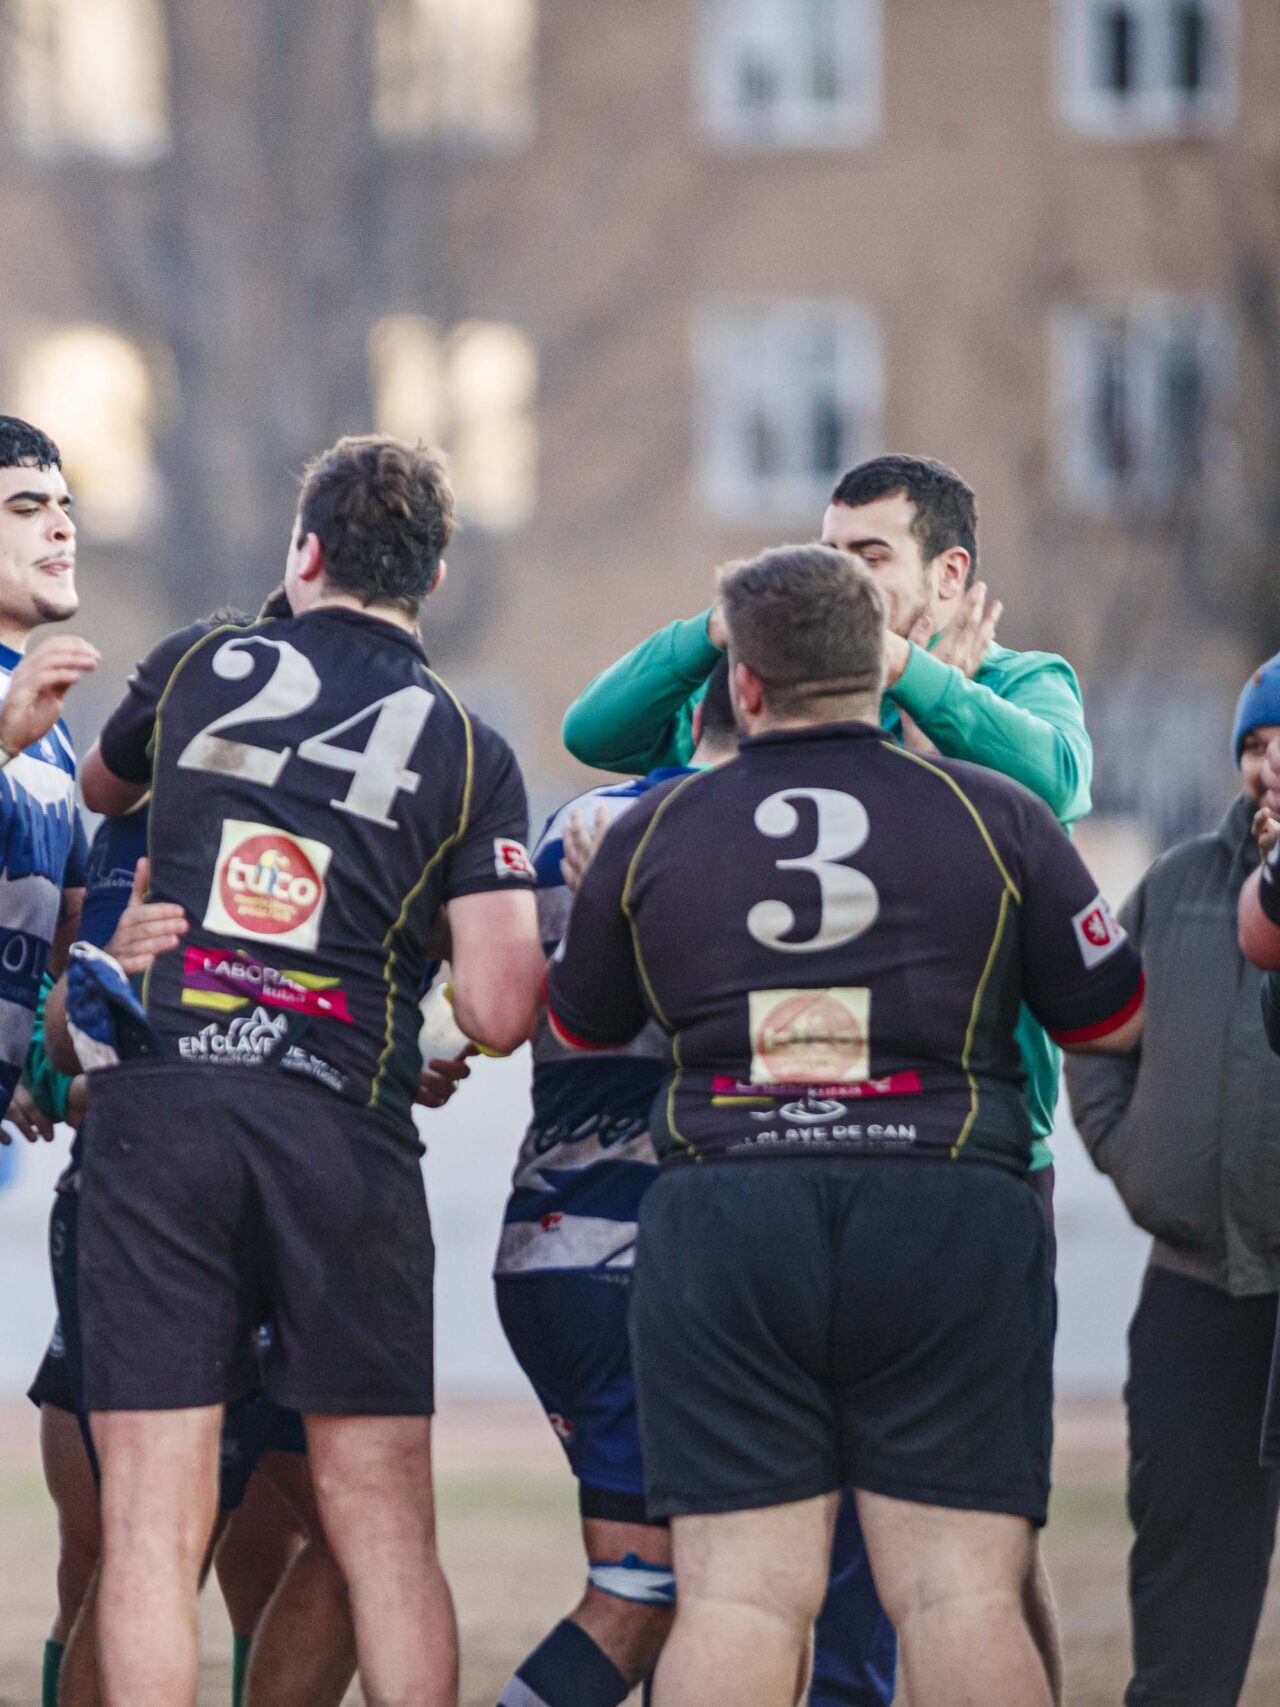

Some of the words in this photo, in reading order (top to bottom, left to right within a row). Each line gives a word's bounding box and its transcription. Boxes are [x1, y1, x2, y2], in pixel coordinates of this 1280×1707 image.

[177, 635, 436, 830] 24
[746, 787, 880, 953] 3
[866, 1123, 917, 1141] CAN
